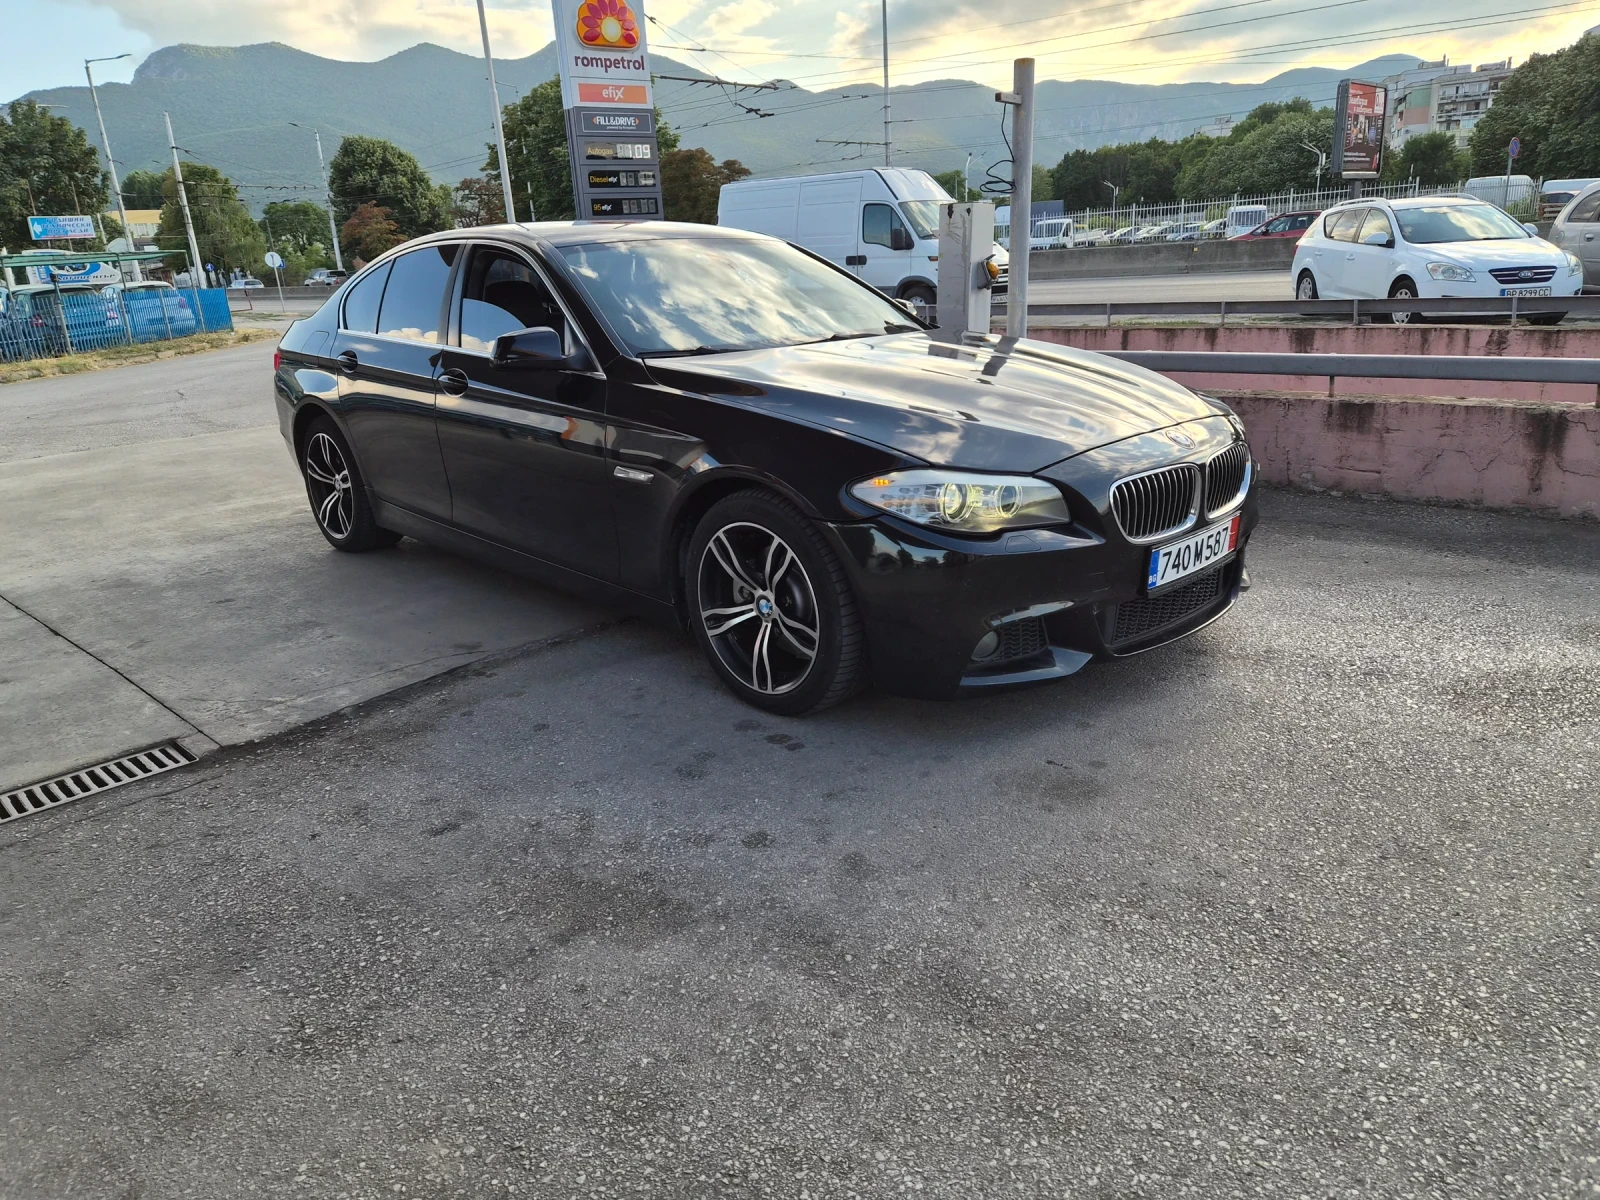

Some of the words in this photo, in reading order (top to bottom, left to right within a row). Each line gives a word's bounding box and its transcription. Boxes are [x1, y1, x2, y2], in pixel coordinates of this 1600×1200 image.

[574, 55, 645, 73] rompetrol
[602, 86, 625, 101] efix
[596, 116, 636, 126] FILL&DRIVE
[587, 147, 613, 155] Autogas
[1160, 544, 1191, 580] 740
[1205, 526, 1229, 560] 587
[1148, 574, 1157, 584] BG
